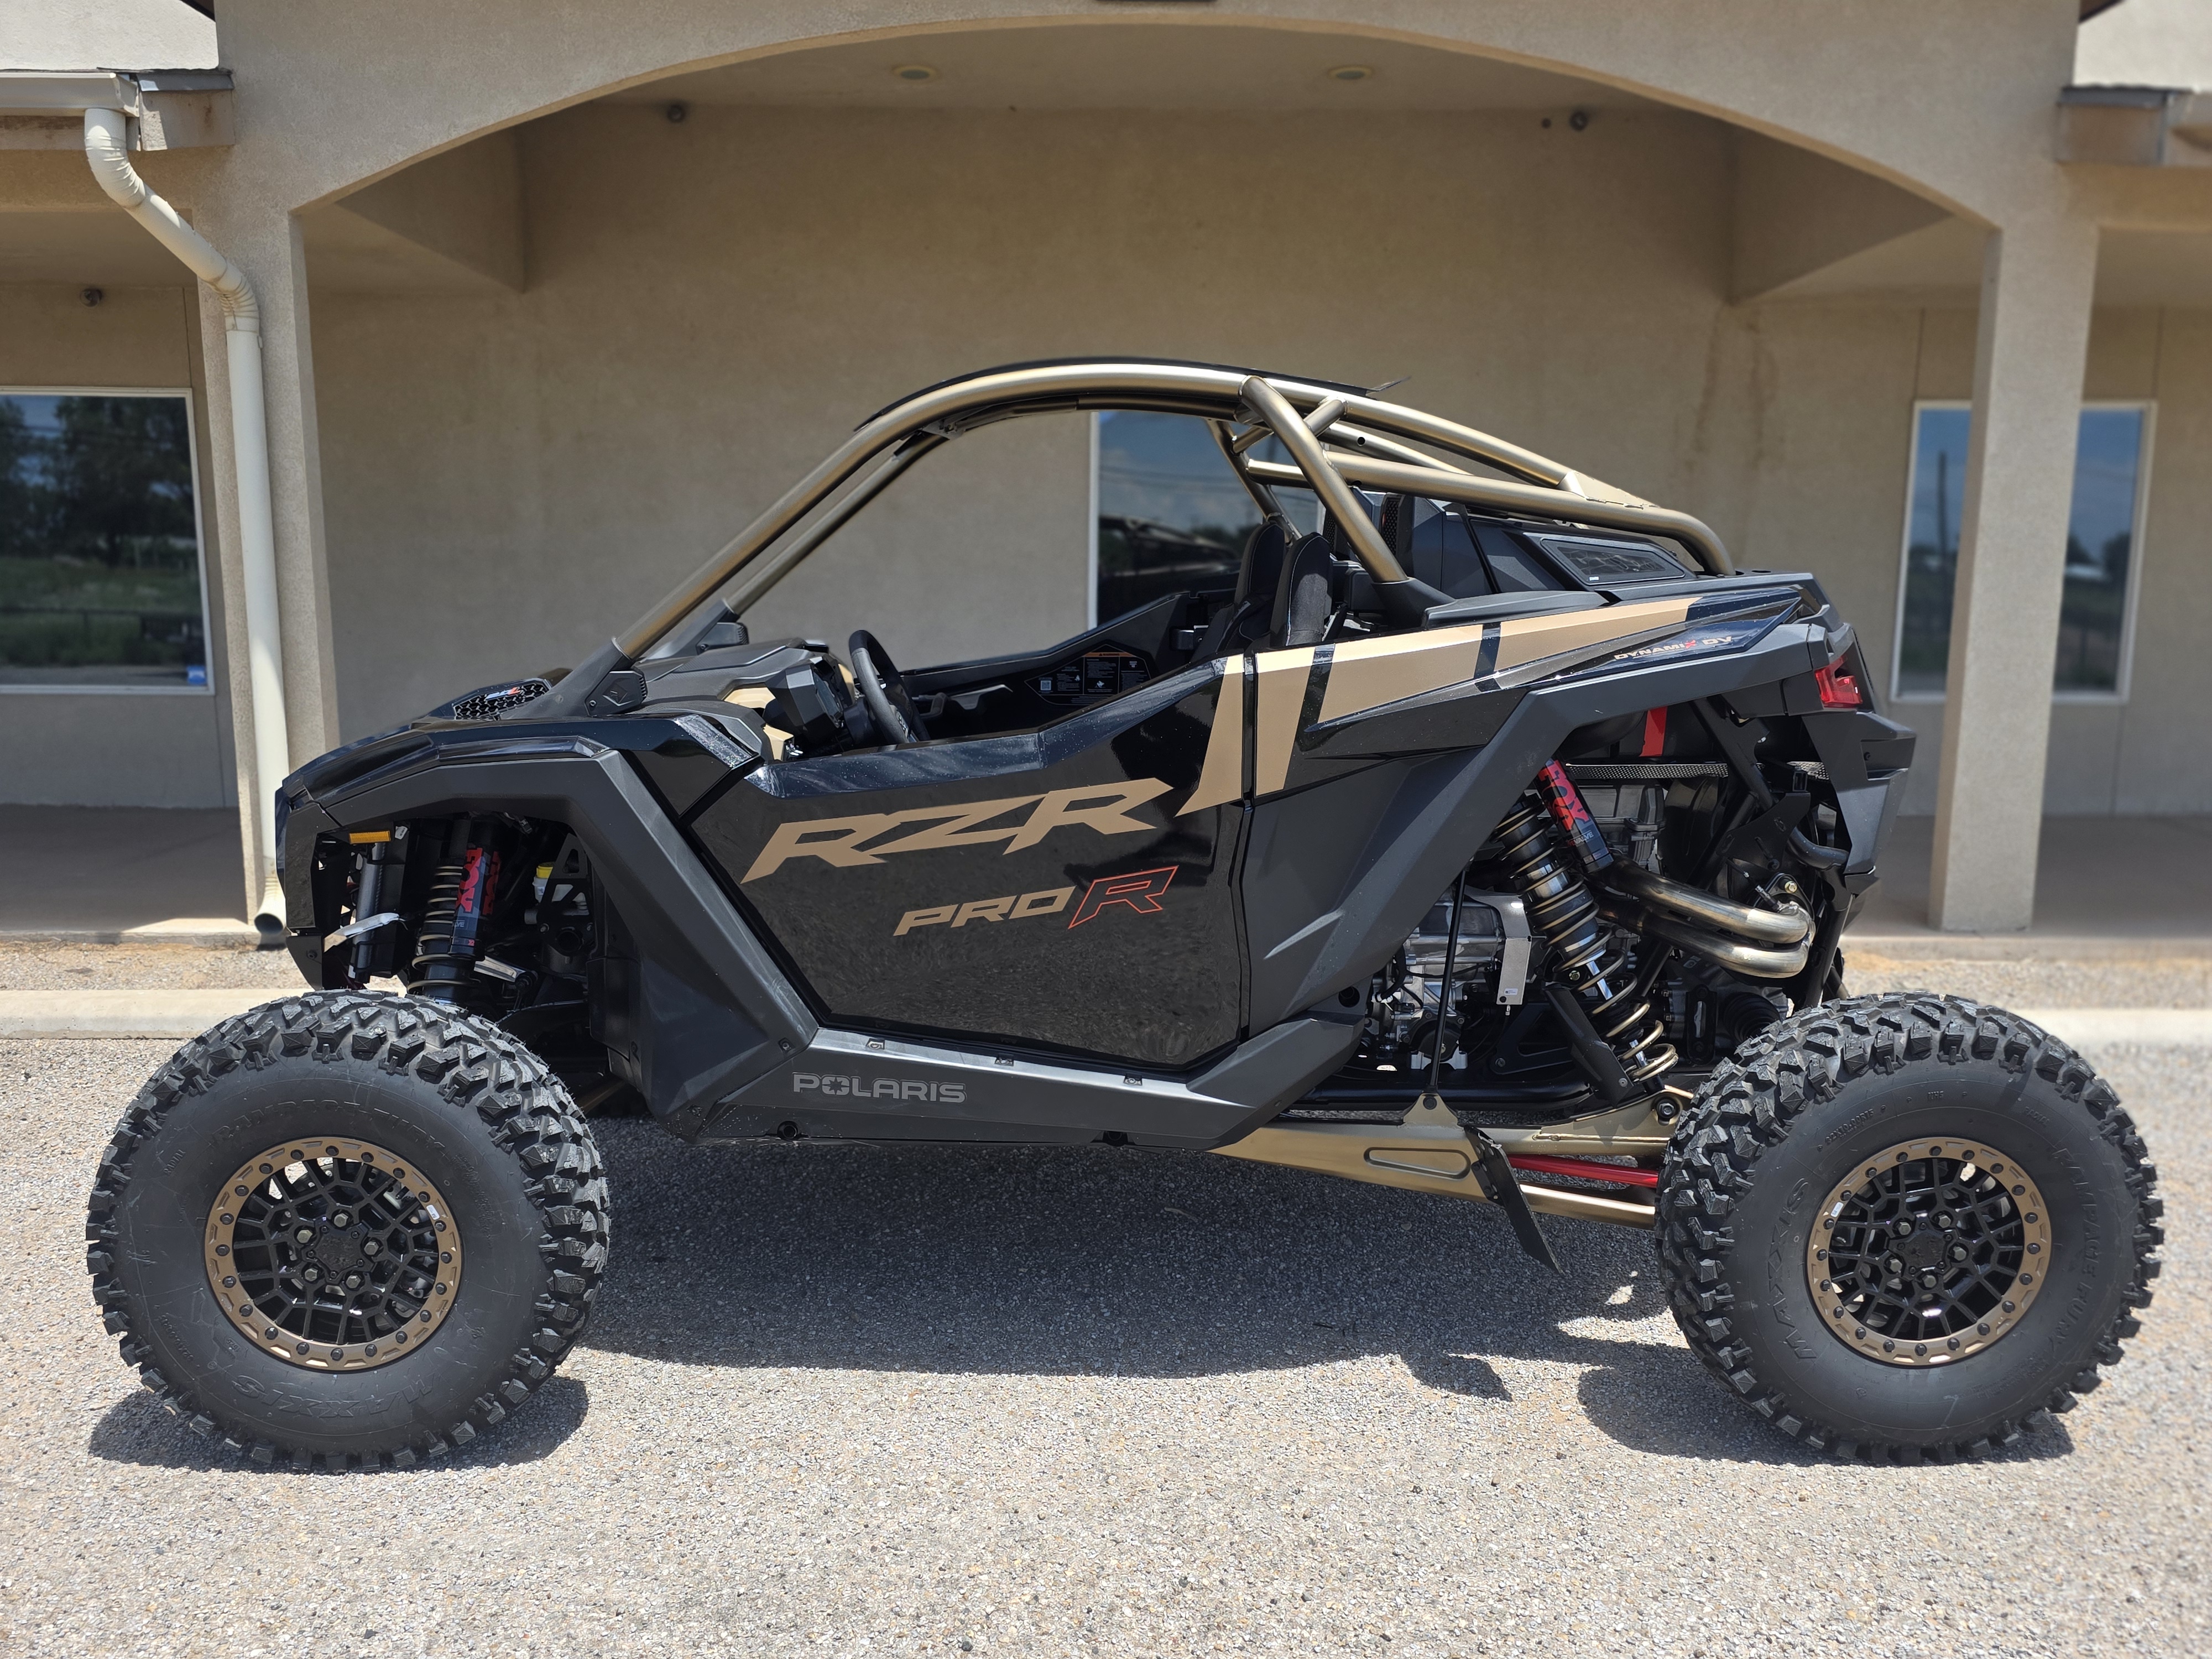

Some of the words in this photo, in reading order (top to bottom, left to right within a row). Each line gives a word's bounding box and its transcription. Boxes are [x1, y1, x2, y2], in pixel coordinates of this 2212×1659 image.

[1614, 640, 1696, 660] DYNAMIX
[1702, 636, 1732, 646] DV
[1537, 759, 1590, 831] FOX
[740, 778, 1175, 884] RZR
[455, 847, 483, 912] FOX
[893, 886, 1077, 936] PRO
[1068, 865, 1179, 929] R
[792, 1072, 967, 1103] POLARIS
[164, 1149, 186, 1175] RADIAL
[1767, 1177, 1817, 1359] MAXXIS
[231, 1370, 442, 1418] MAXXIS
